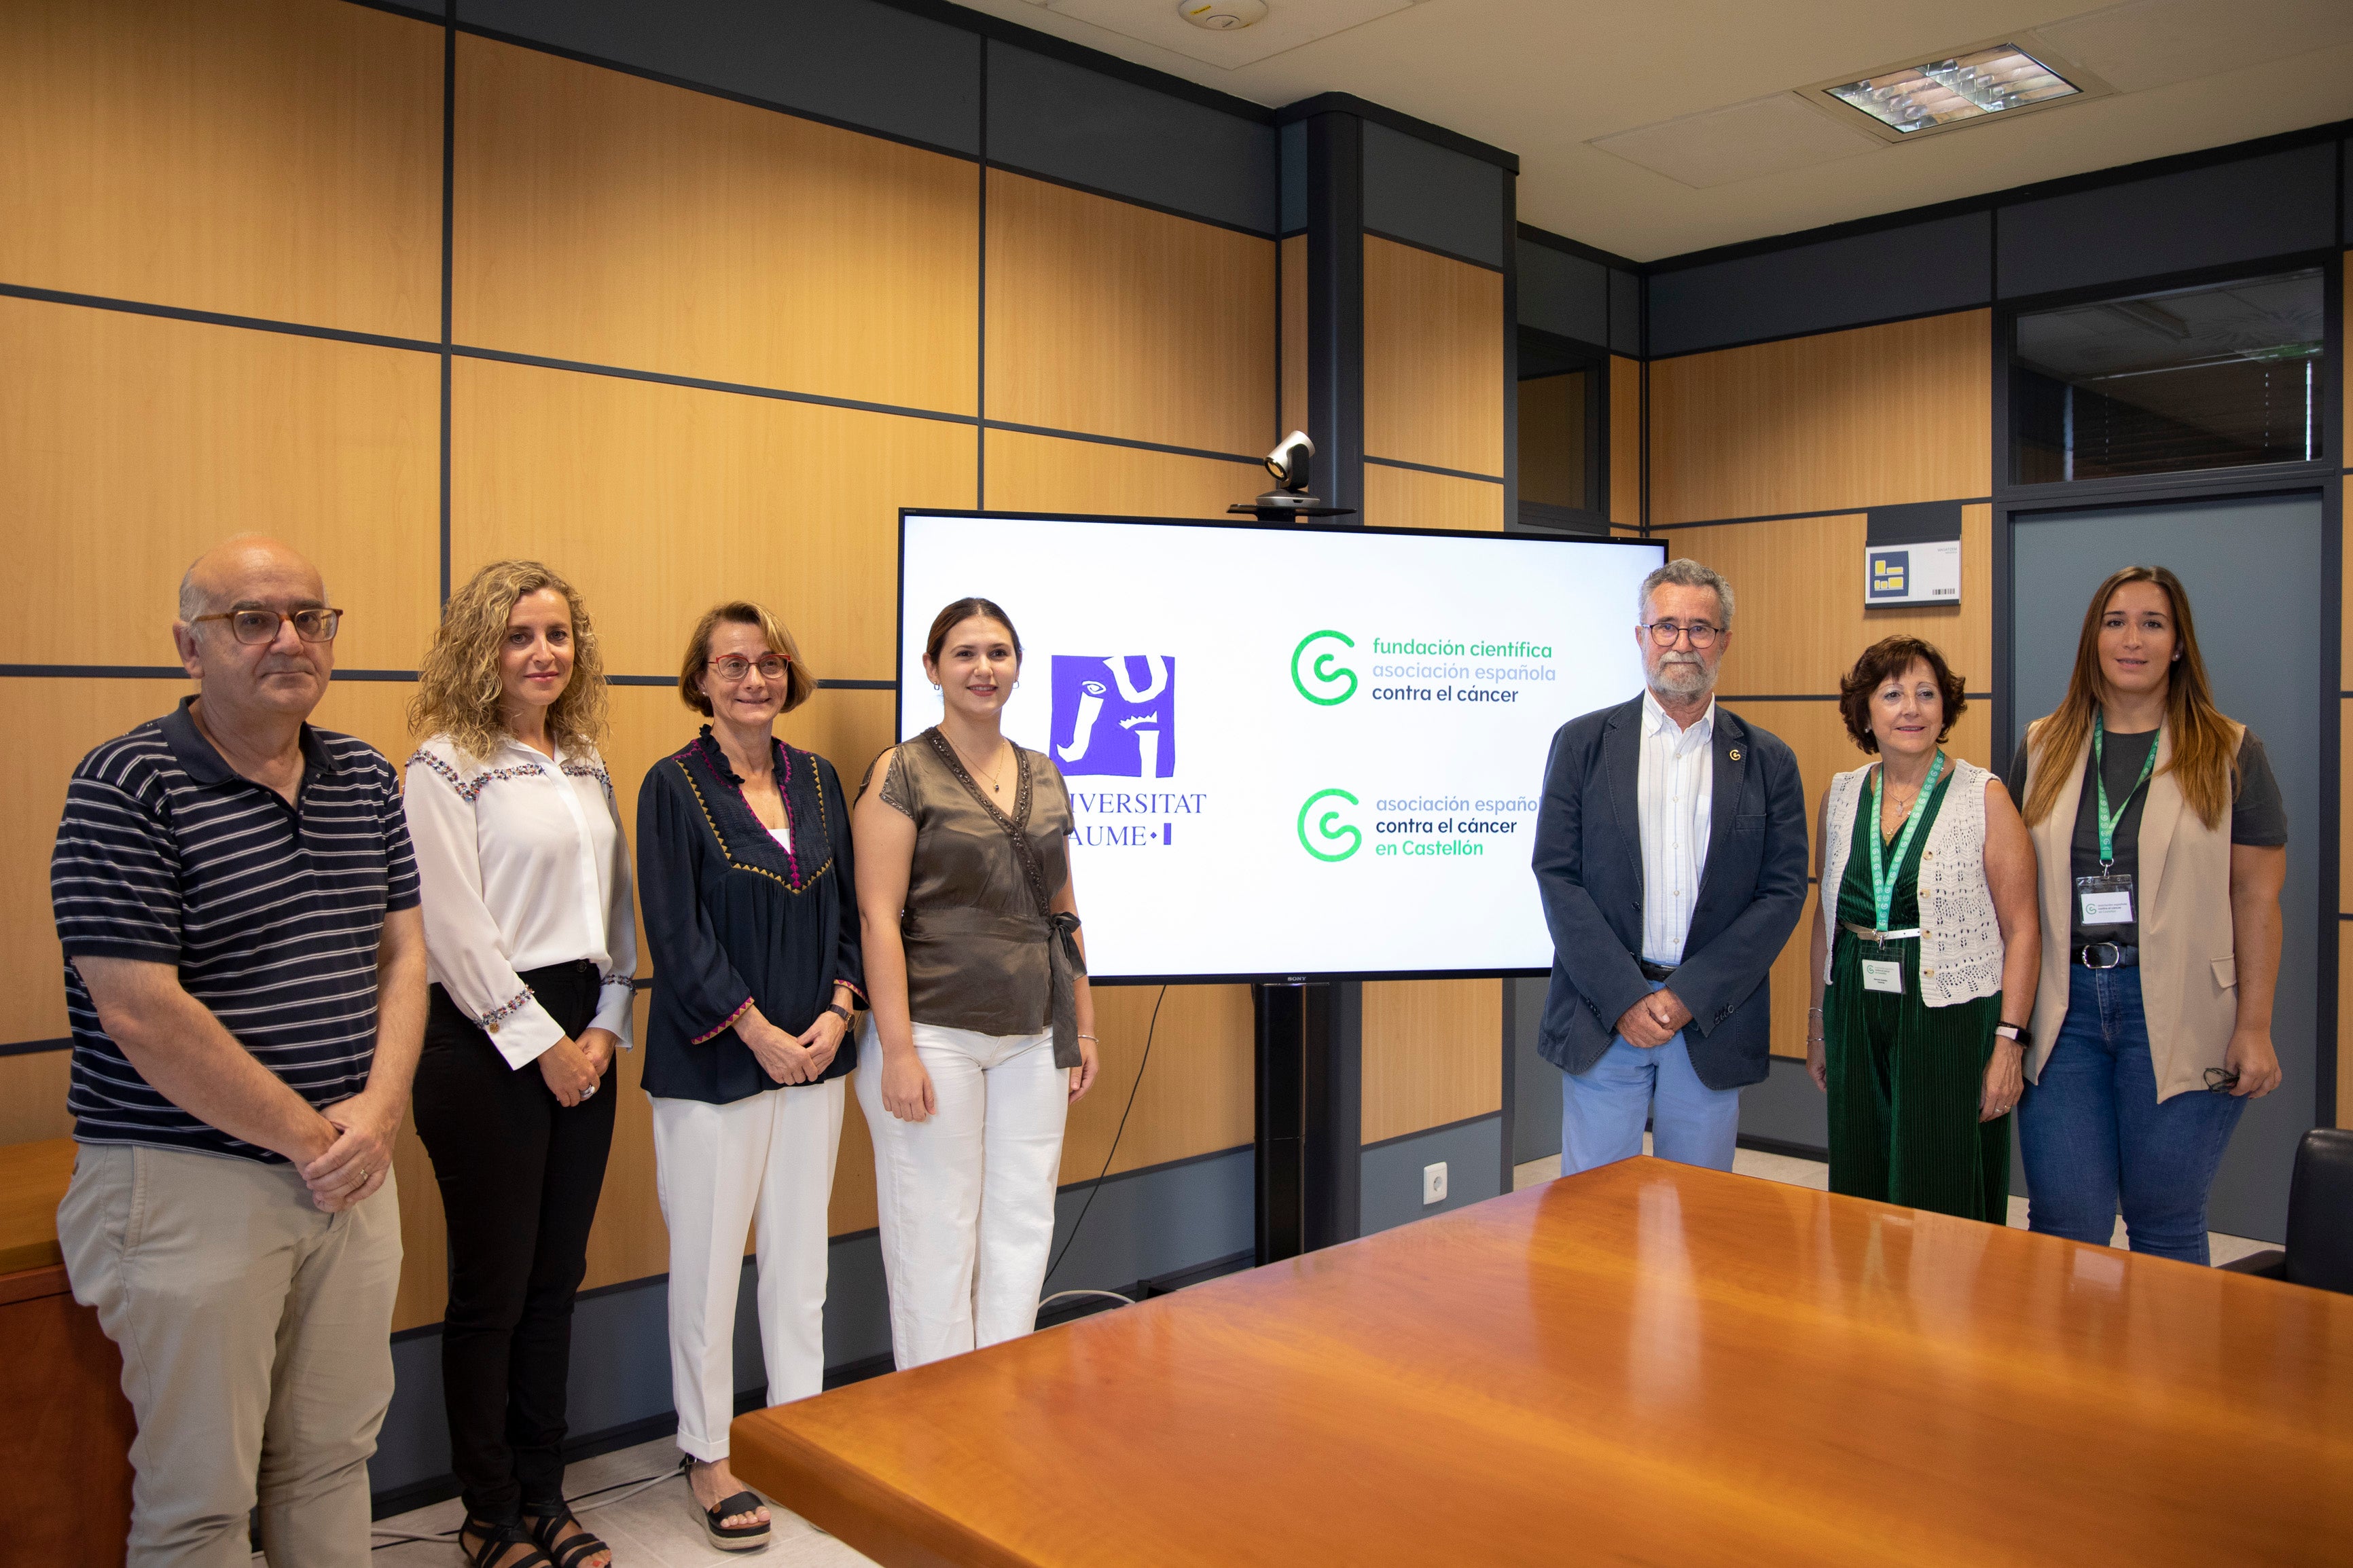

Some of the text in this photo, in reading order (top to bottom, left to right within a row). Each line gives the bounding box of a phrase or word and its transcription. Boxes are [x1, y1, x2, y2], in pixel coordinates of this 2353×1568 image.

[1373, 637, 1552, 659] fundación científica
[1373, 662, 1556, 686] asociación española
[1372, 685, 1519, 703] contra el cáncer
[1069, 793, 1207, 814] IVERSITAT
[1376, 795, 1541, 816] asociación españo
[1376, 817, 1517, 834] contra el cáncer
[1068, 826, 1147, 846] AUME
[1375, 839, 1484, 856] en Castellón
